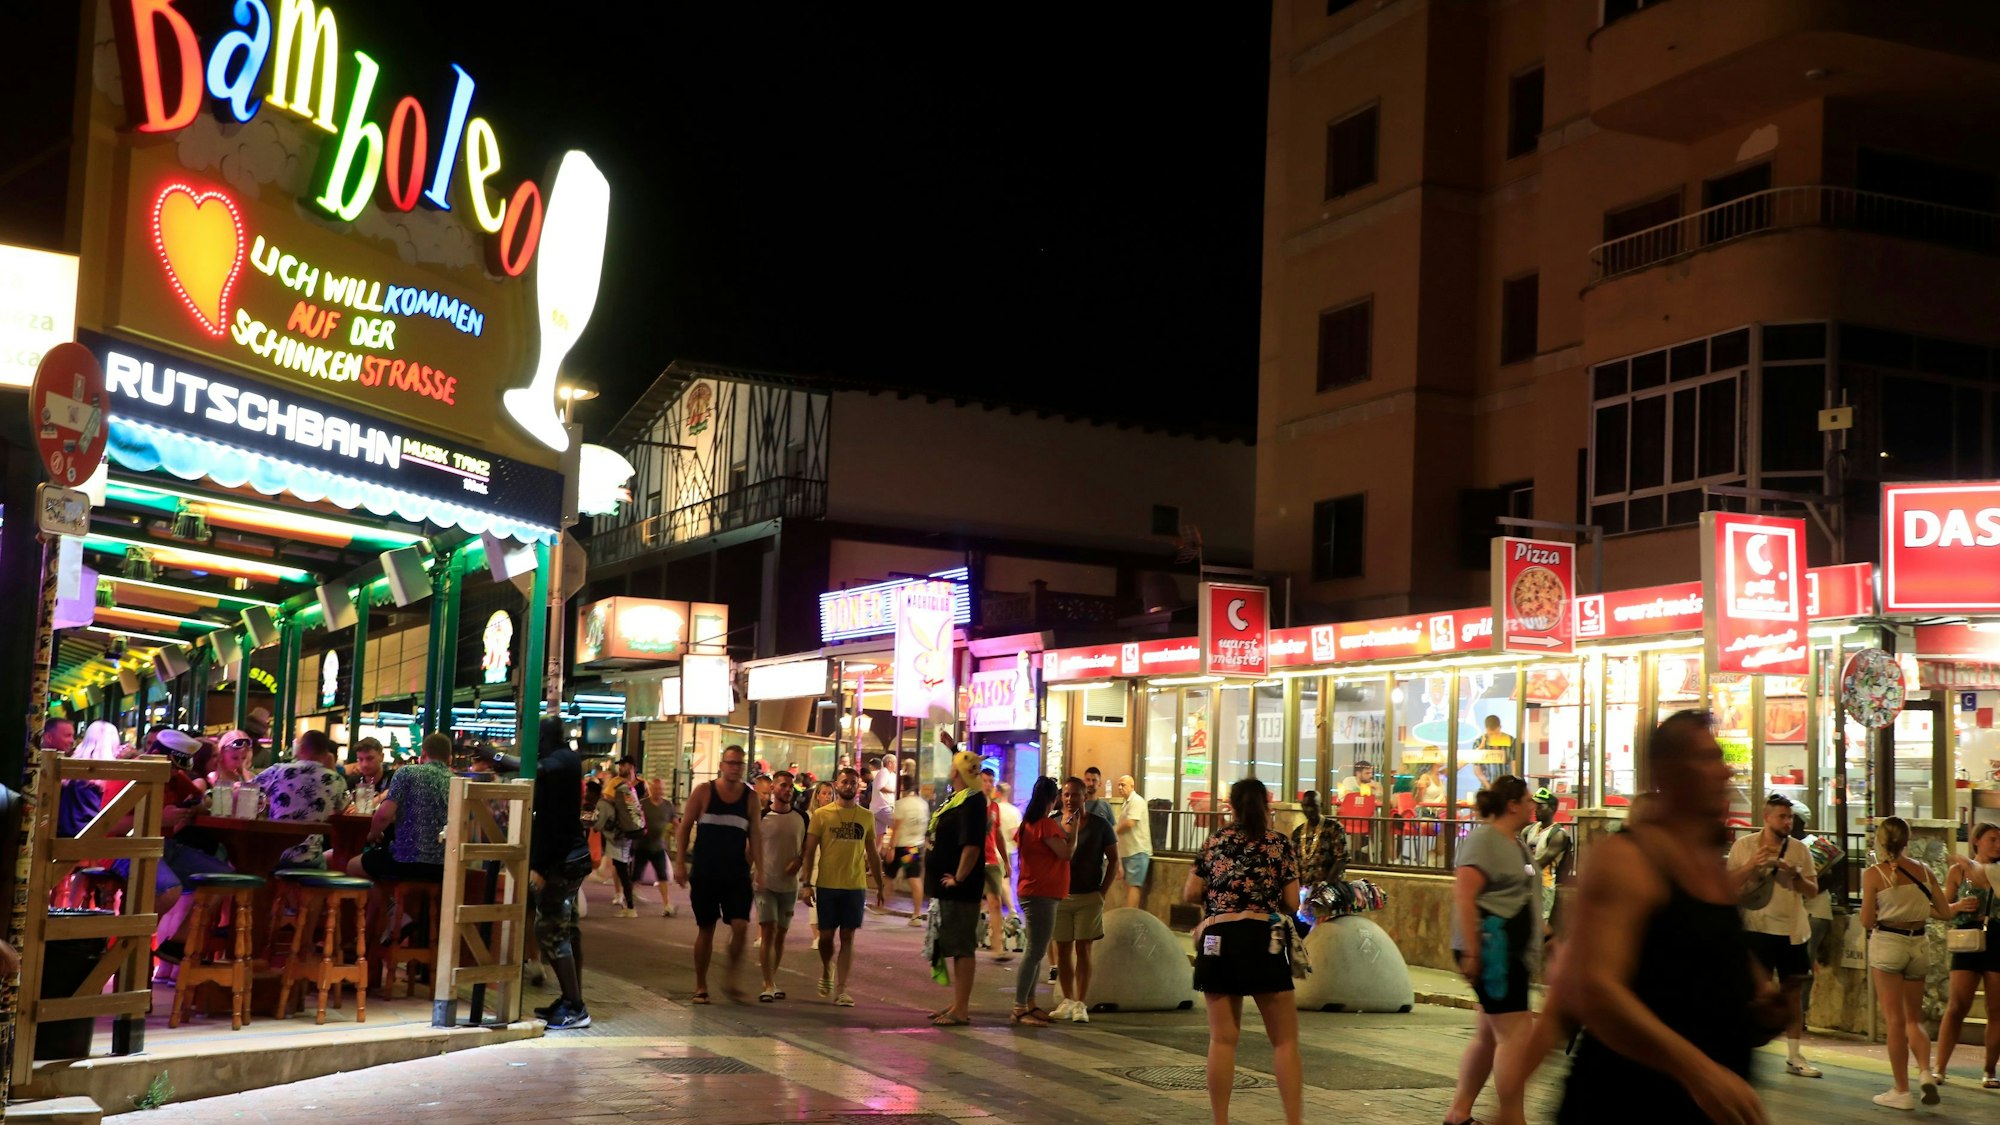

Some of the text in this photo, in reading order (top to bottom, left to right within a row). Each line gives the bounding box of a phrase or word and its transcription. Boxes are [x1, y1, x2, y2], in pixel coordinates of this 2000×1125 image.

[131, 0, 542, 278] Bamboleo
[250, 235, 320, 297] LICH
[323, 271, 486, 337] WILLKOMMEN
[287, 301, 396, 350] AUF DER
[230, 307, 458, 406] SCHINKENSTRASSE
[105, 351, 402, 470] RUTSCHBAHN
[1904, 507, 2000, 548] DAS
[1514, 542, 1560, 565] Pizza
[1614, 593, 1703, 621] wurstmeis
[1213, 653, 1263, 666] meister
[1218, 639, 1258, 649] wurst
